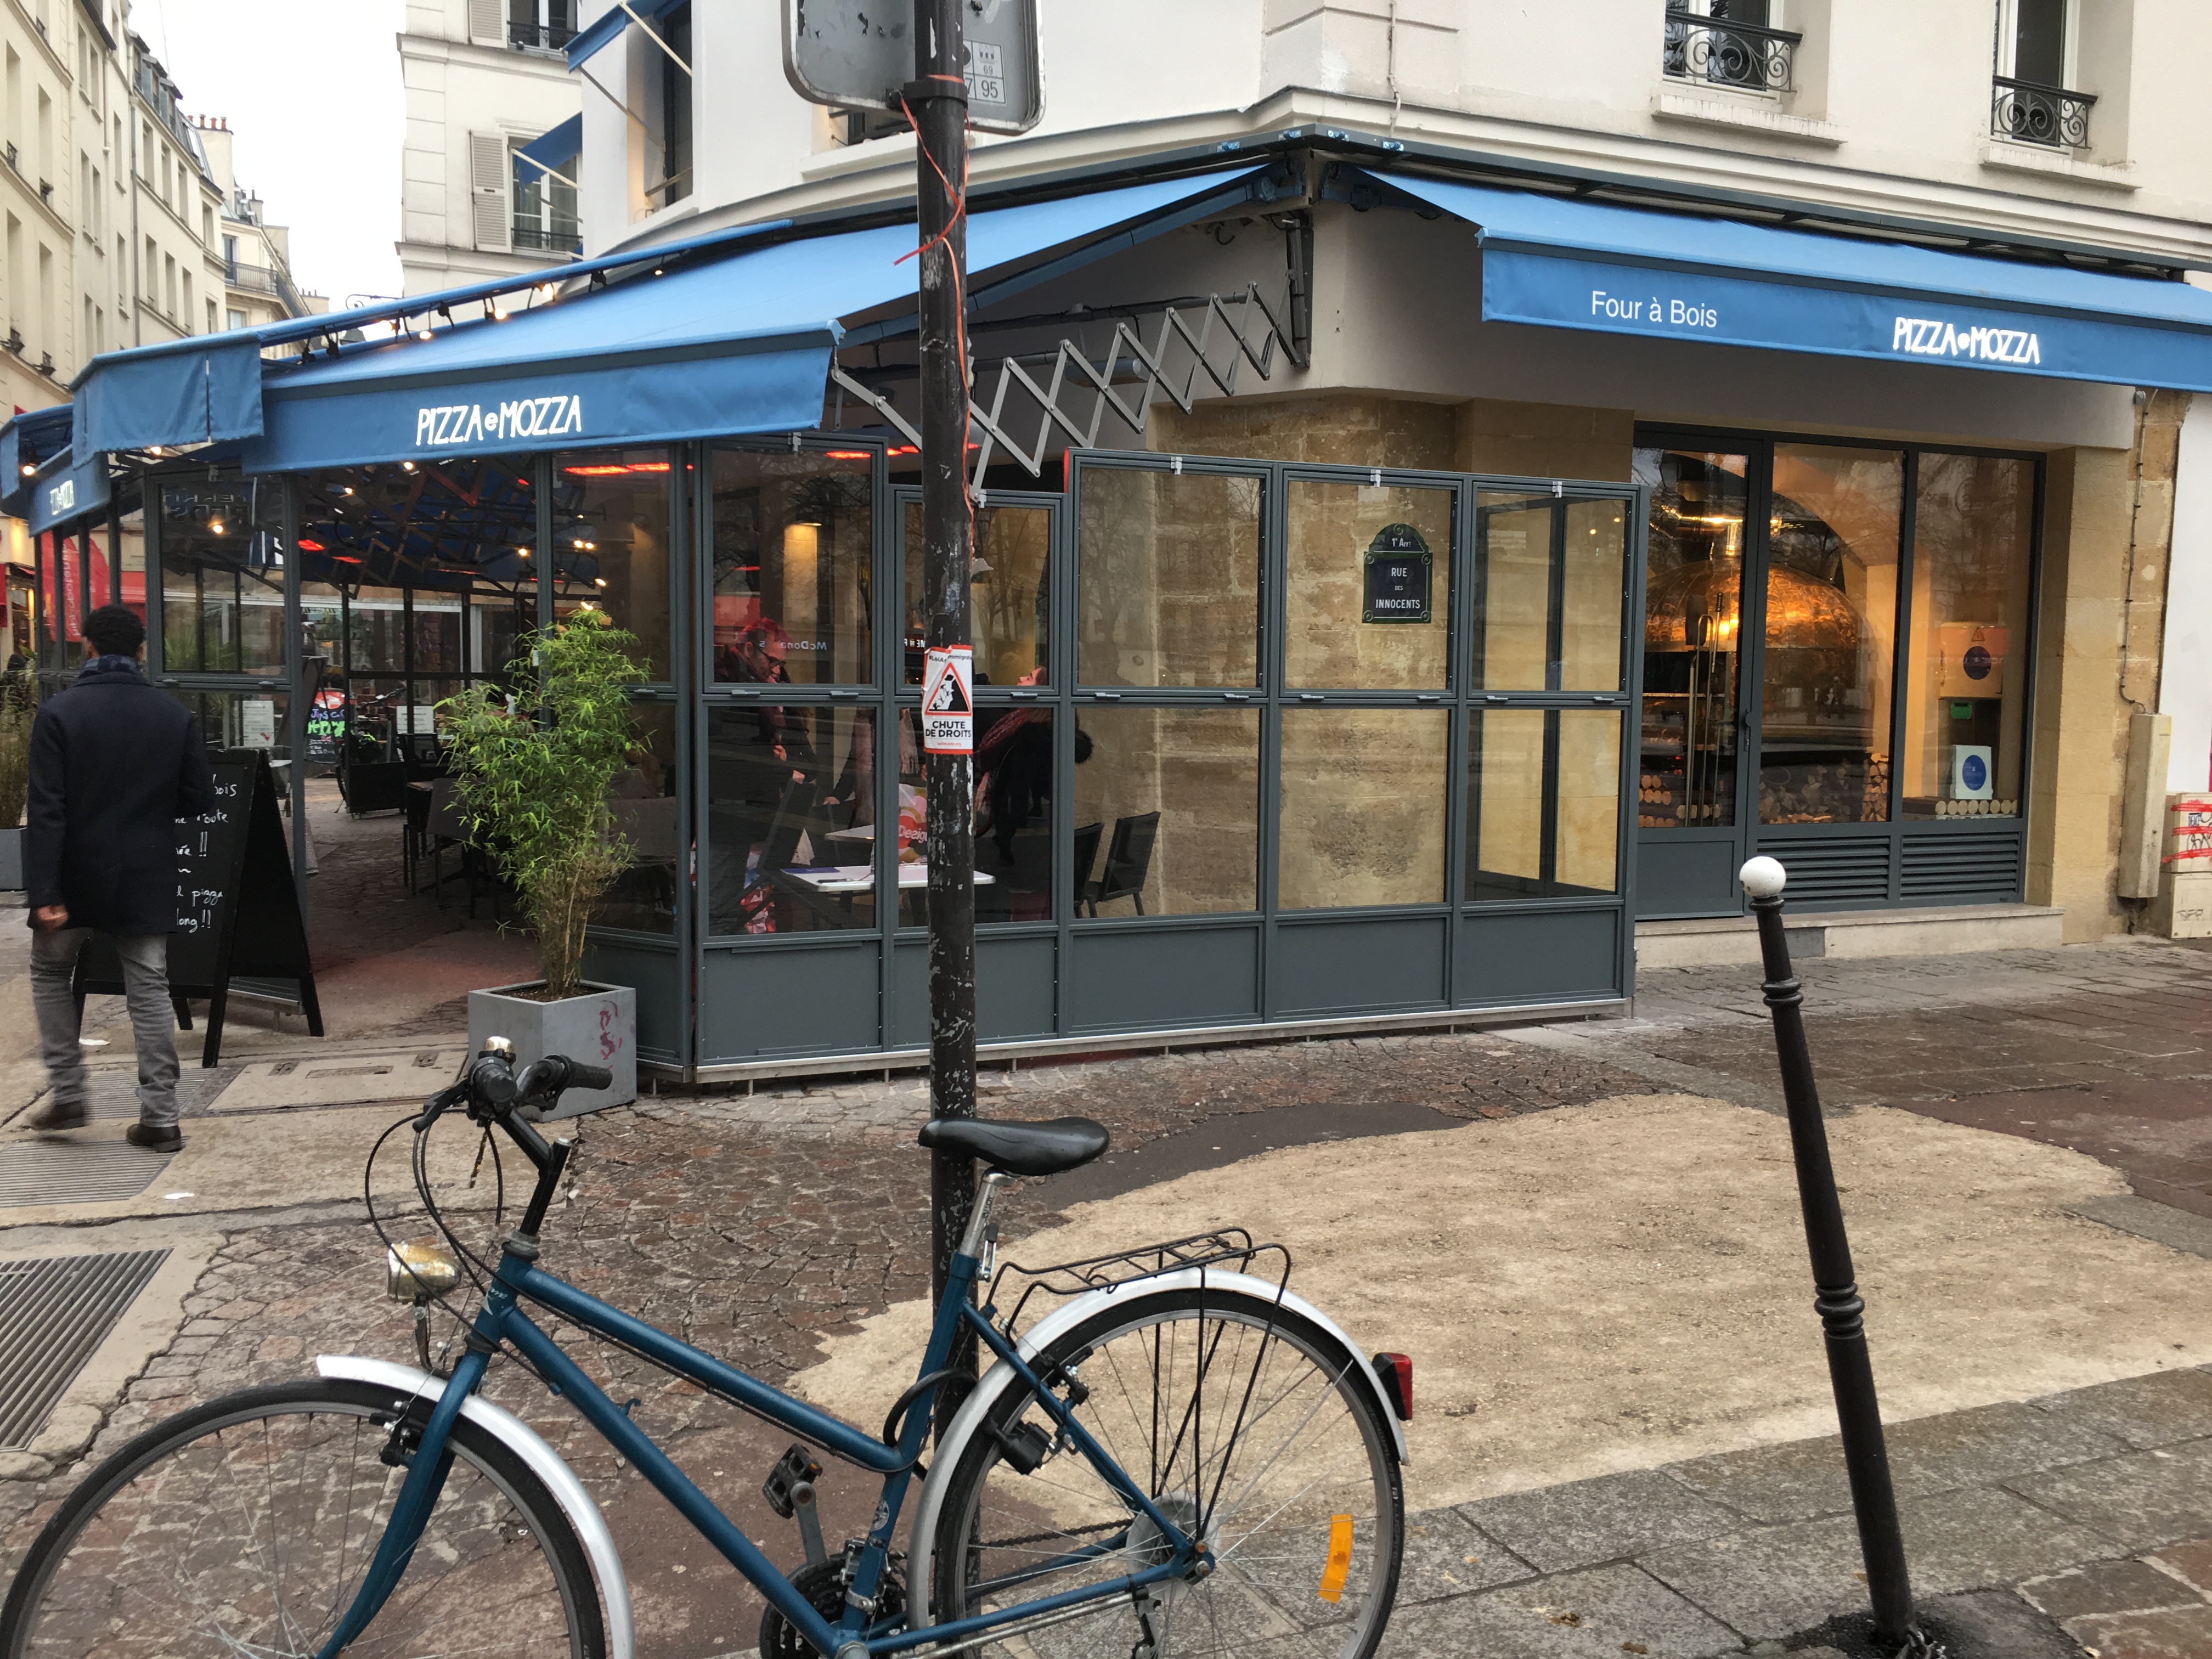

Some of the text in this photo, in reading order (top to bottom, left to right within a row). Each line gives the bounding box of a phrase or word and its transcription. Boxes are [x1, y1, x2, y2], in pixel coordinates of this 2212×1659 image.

[980, 79, 998, 99] 95
[1592, 290, 1718, 328] Four à Bois
[1391, 567, 1408, 577] RUE
[1375, 599, 1421, 609] INNOCENTS
[932, 720, 966, 730] CHUTE
[925, 729, 971, 738] DE DROITS
[191, 888, 224, 907] pizza
